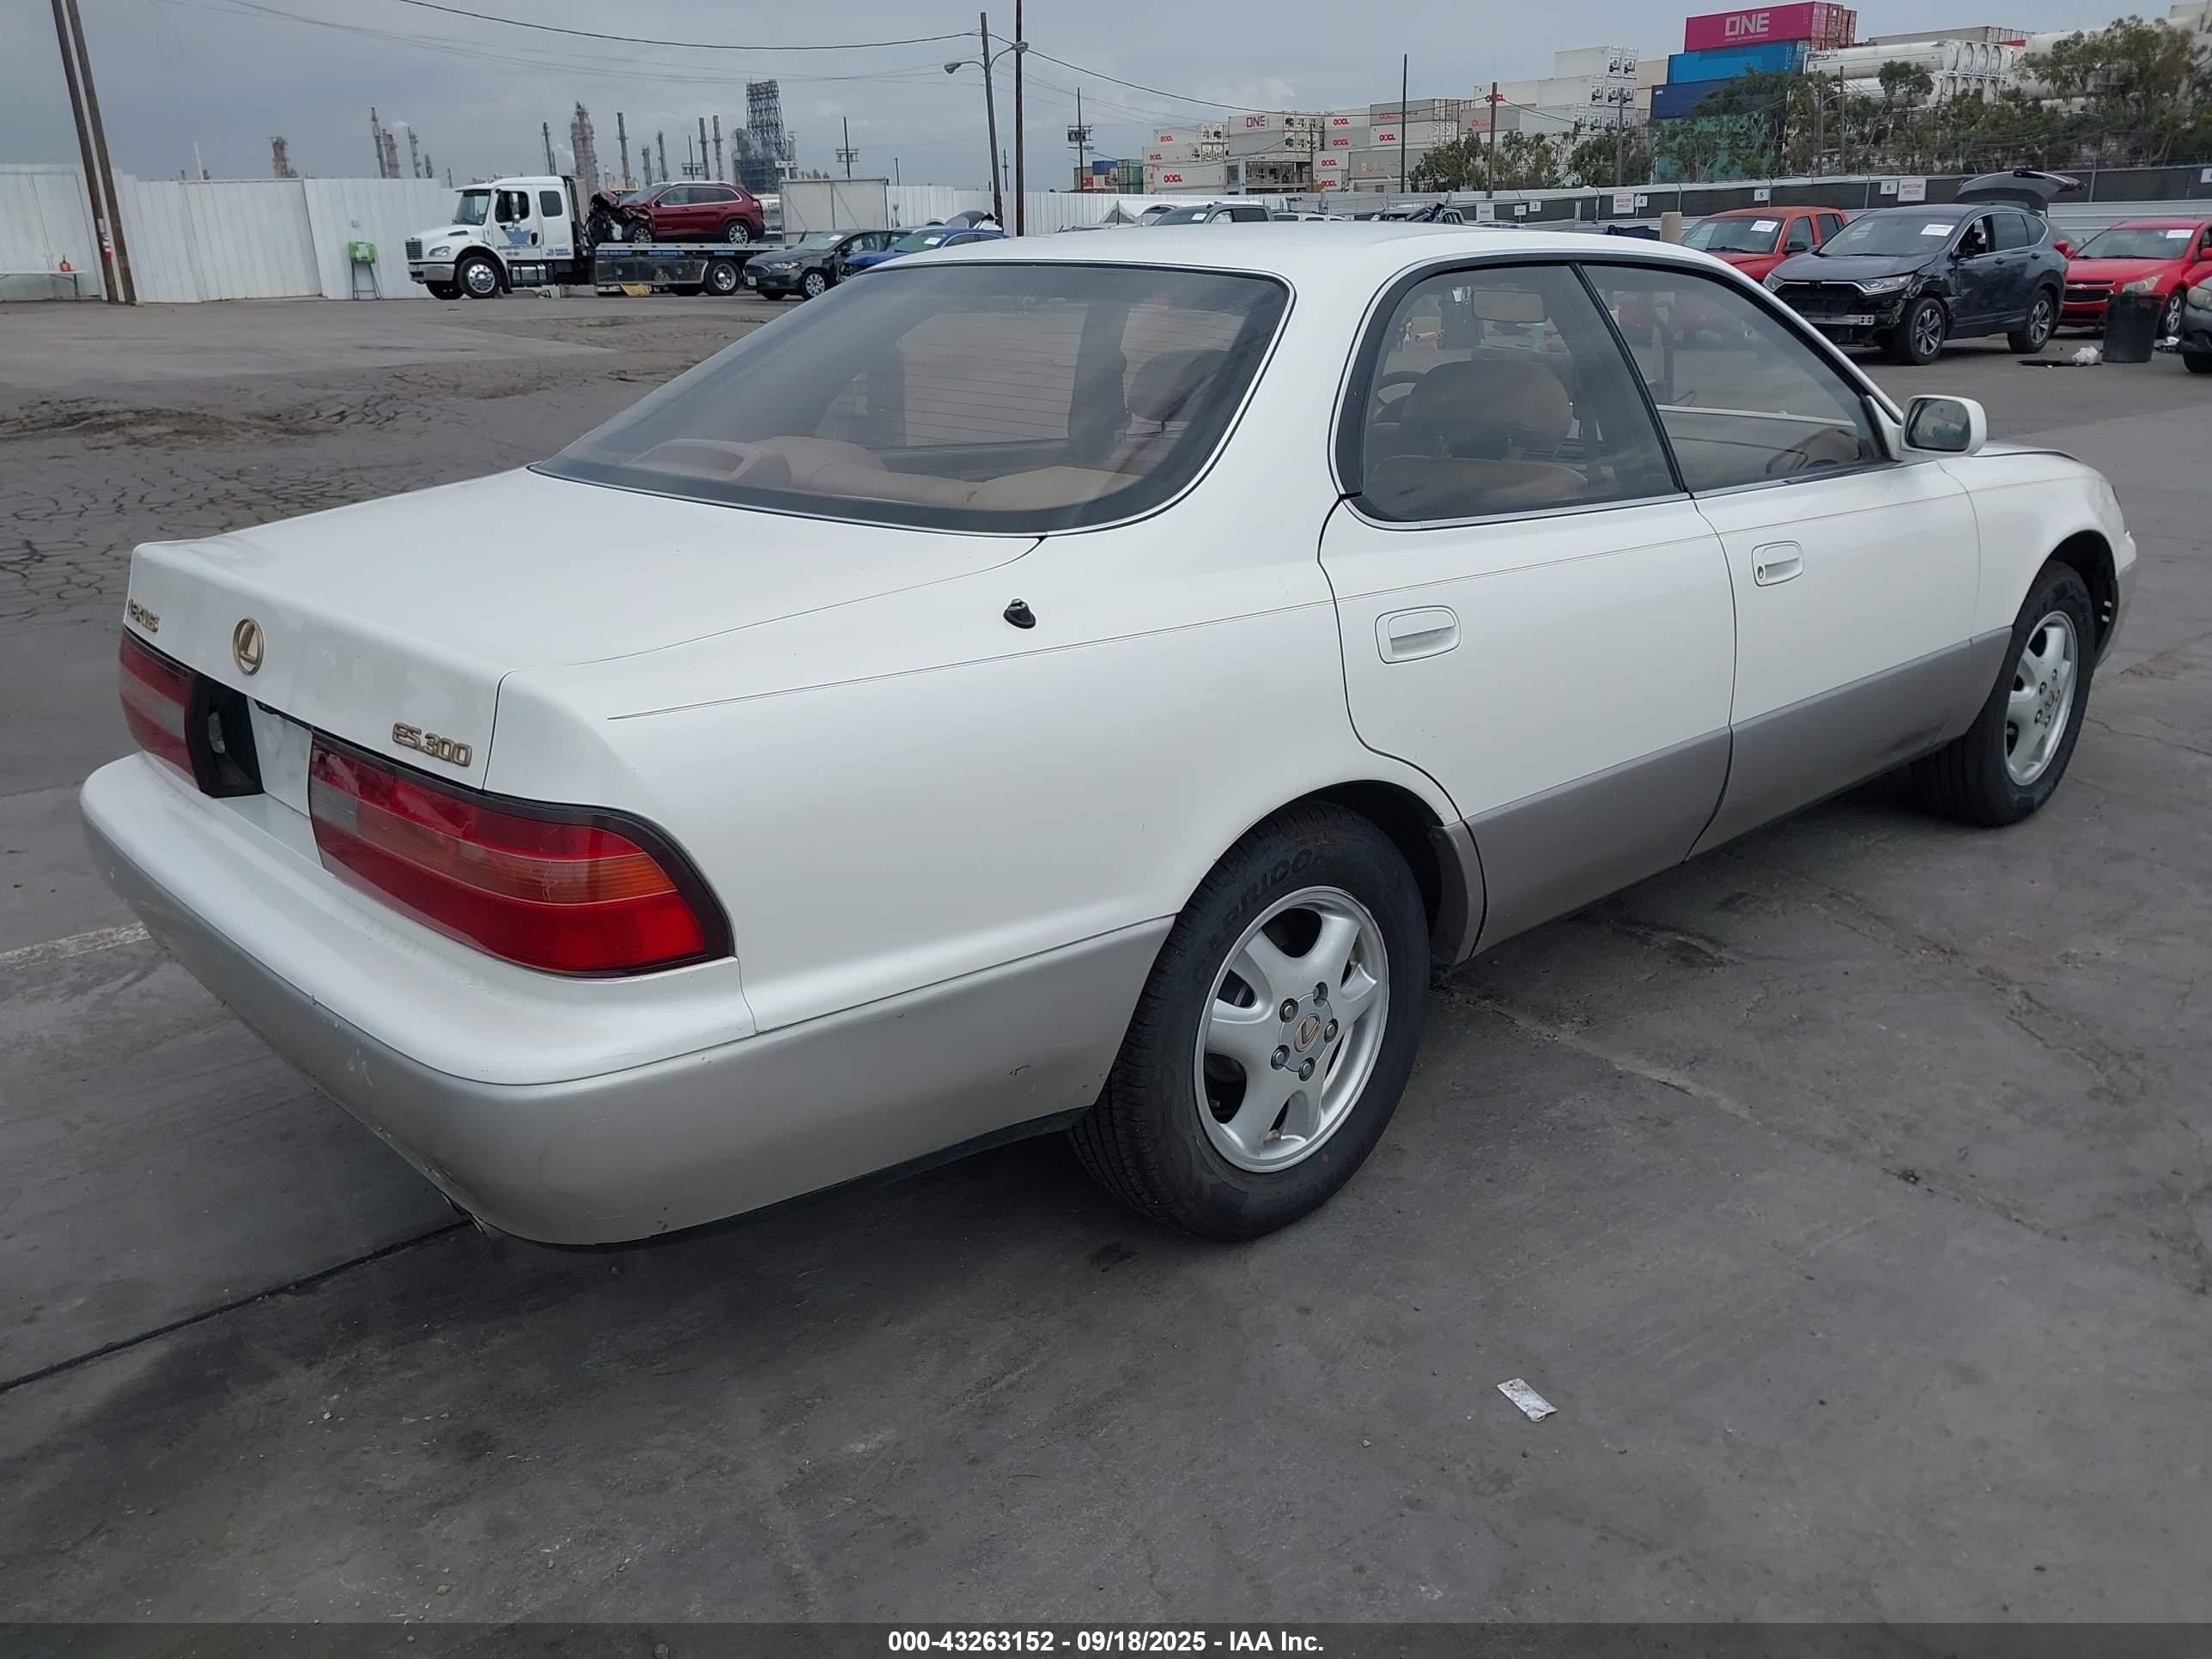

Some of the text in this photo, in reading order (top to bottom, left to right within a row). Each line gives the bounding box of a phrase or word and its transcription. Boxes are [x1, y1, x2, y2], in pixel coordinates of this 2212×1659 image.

[1724, 12, 1770, 37] ONE
[1486, 93, 1505, 102] OCL
[1246, 115, 1266, 128] ONE
[1379, 133, 1396, 142] OOCL
[1164, 174, 1183, 183] OOCL
